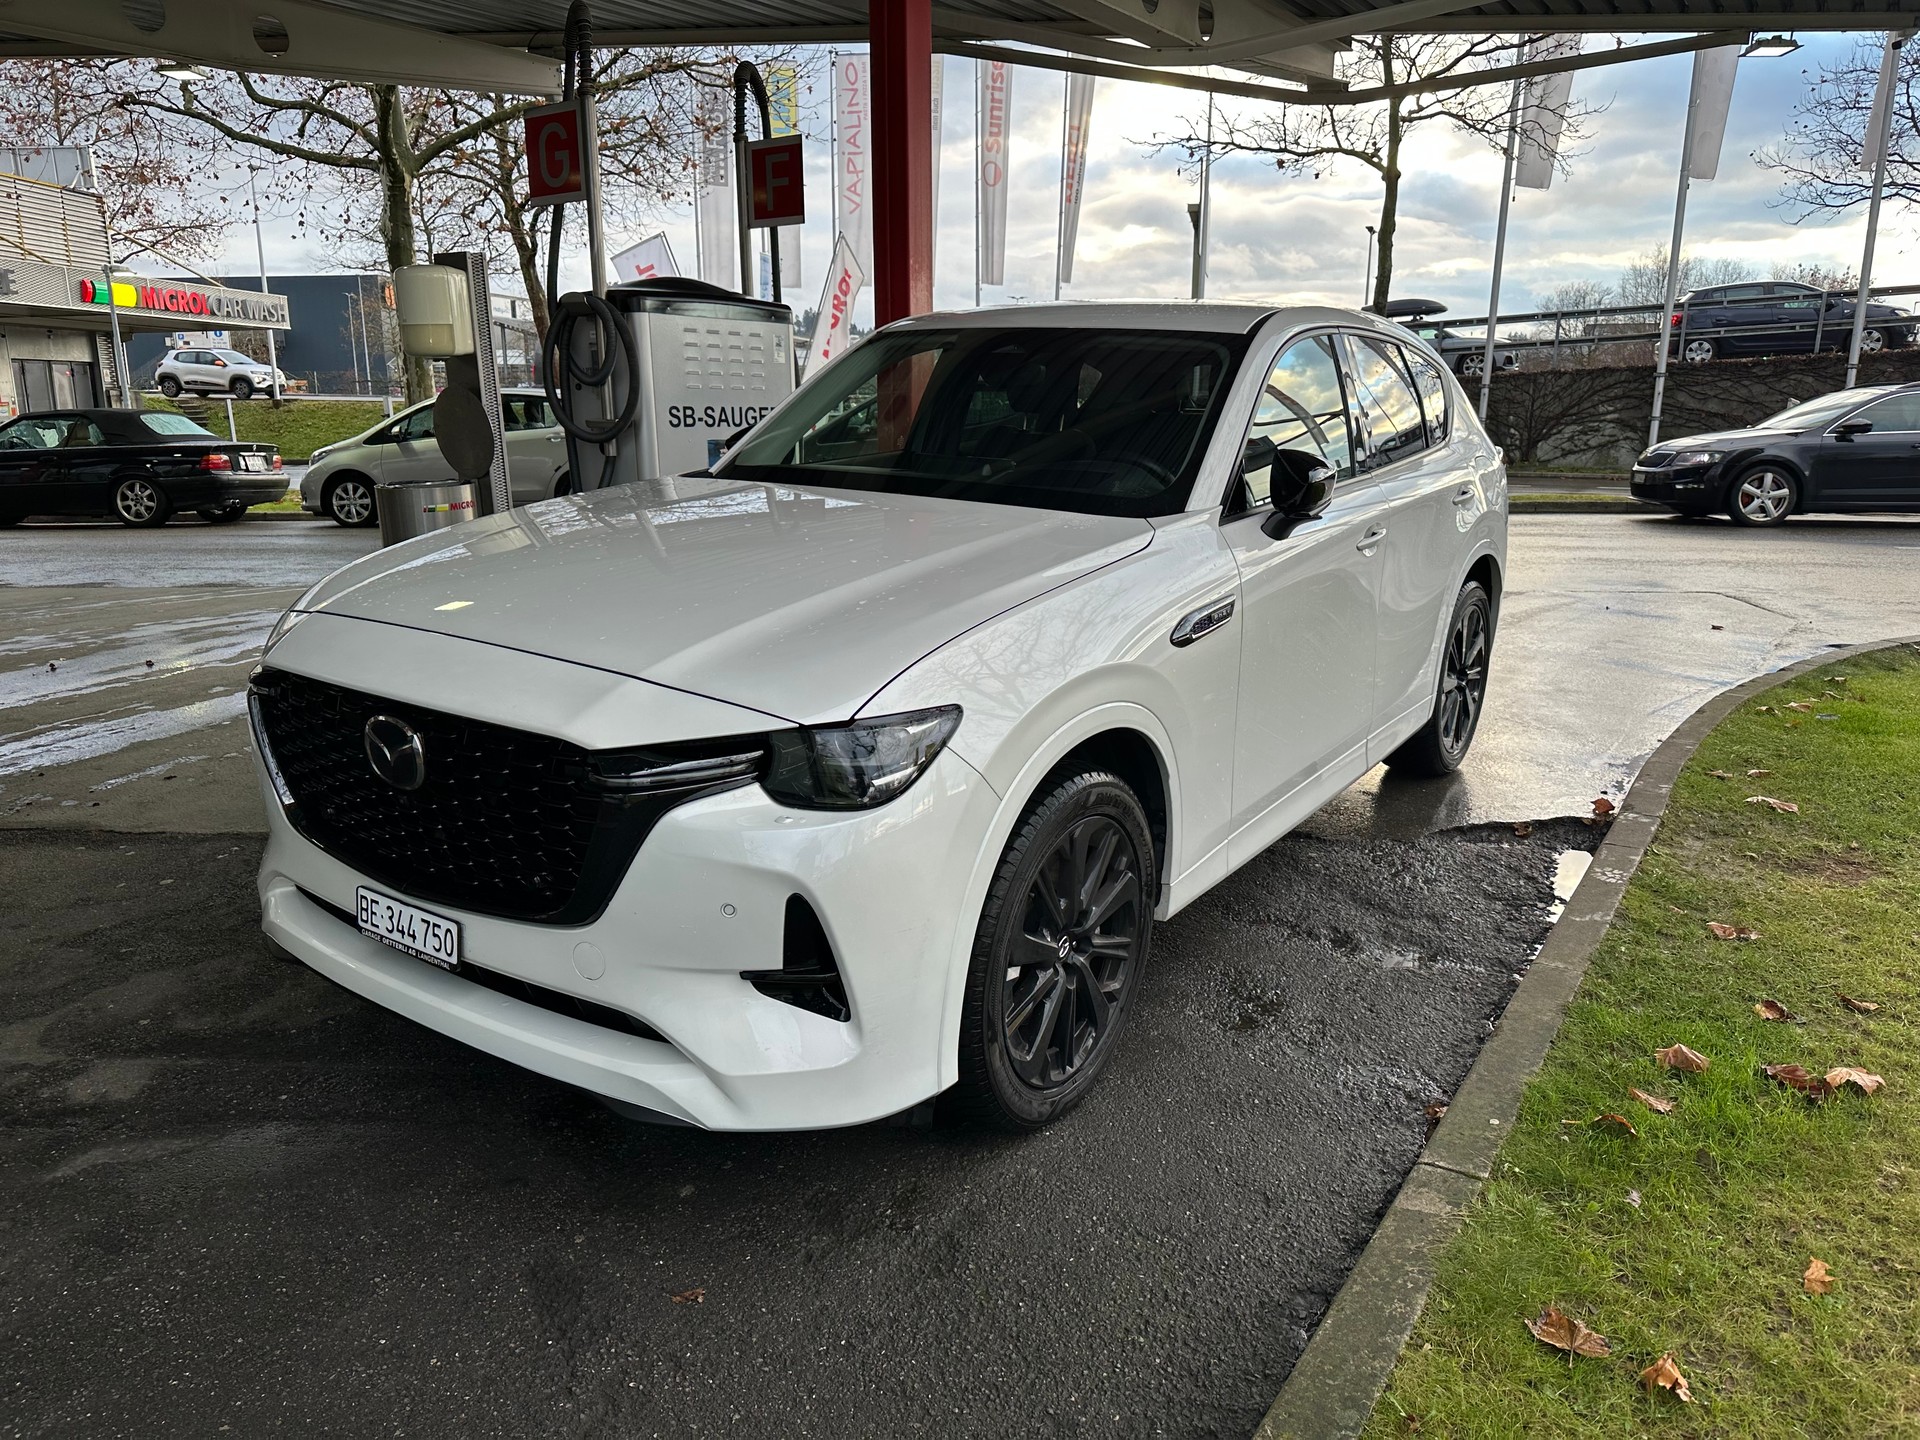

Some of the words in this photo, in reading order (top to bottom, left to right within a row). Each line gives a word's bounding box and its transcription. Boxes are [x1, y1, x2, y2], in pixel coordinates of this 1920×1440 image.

[539, 122, 570, 188] G
[765, 152, 789, 212] F
[210, 294, 246, 319] CAR
[244, 298, 287, 323] WASH
[668, 405, 776, 428] SB-SAUGE
[450, 500, 476, 511] MIGRO
[361, 928, 381, 942] GARAGE
[417, 951, 451, 971] LANGENTHAL
